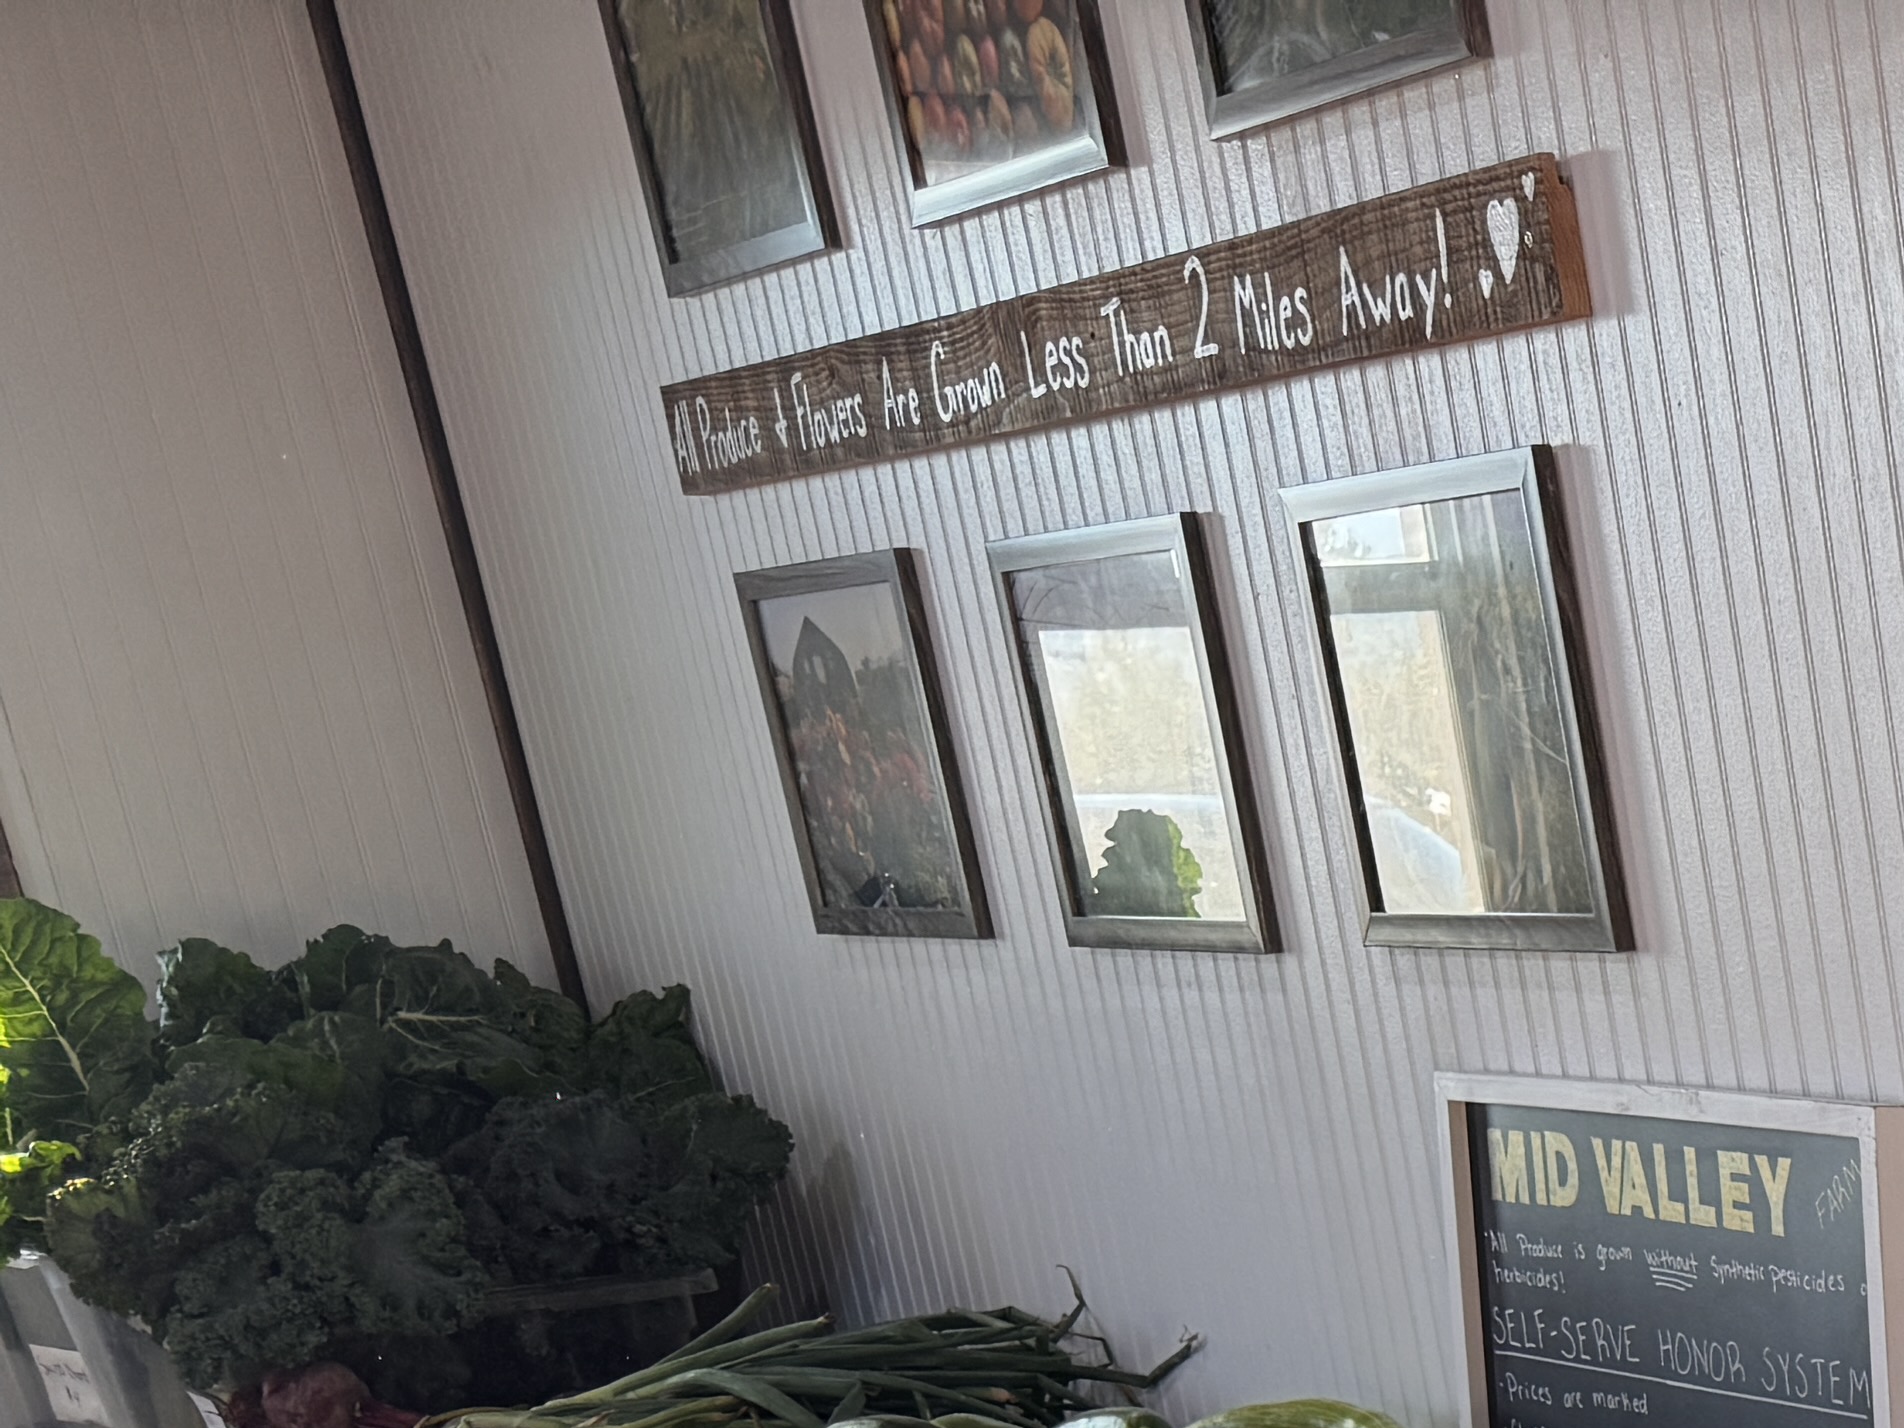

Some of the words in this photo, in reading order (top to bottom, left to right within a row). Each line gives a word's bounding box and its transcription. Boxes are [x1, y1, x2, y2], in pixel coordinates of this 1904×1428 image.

[674, 400, 700, 477] All
[695, 395, 762, 470] Produce
[790, 372, 867, 451] Flowers
[882, 356, 921, 431] Are
[931, 340, 1006, 423] Grown
[1020, 330, 1091, 399] Less
[1100, 296, 1174, 377] Than
[1184, 254, 1219, 359] 2
[1233, 271, 1314, 356] Miles
[1340, 207, 1453, 341] Away!
[1487, 1128, 1580, 1208] MID
[1590, 1136, 1791, 1237] VALLEY
[1815, 1158, 1862, 1229] FARM
[1489, 1229, 1508, 1253] All
[1516, 1233, 1563, 1258] Produce
[1573, 1242, 1586, 1260] is
[1596, 1243, 1633, 1271] grown
[1769, 1264, 1845, 1293] pesticides
[1493, 1260, 1566, 1294] herbicides!
[1491, 1306, 1640, 1364] SELF-SERVE
[1658, 1328, 1746, 1384] HONOR
[1761, 1347, 1871, 1409] SYSTEM
[1505, 1372, 1552, 1405] Prices
[1563, 1391, 1583, 1409] are
[1592, 1392, 1648, 1415] marked
